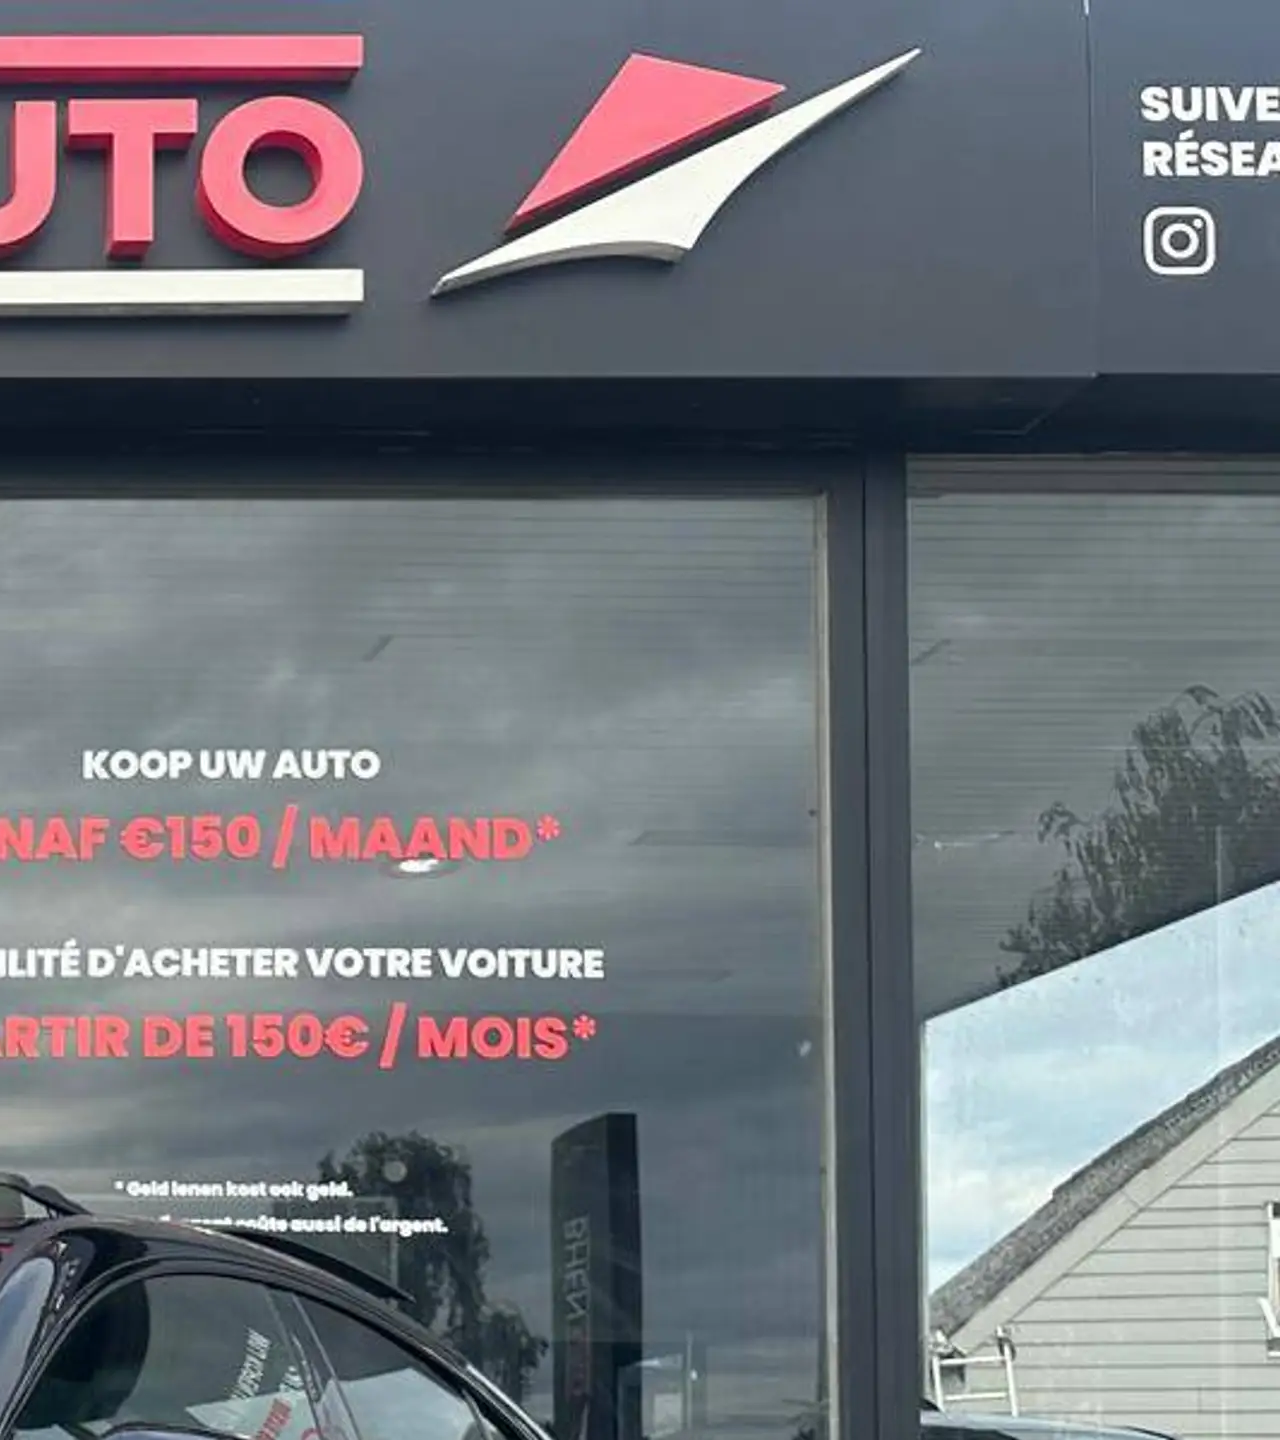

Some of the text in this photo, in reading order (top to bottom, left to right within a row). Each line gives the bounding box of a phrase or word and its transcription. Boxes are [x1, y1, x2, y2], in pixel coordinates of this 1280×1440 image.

[1140, 85, 1280, 121] SUIVE
[82, 748, 381, 780] KOOP UW AUTO
[118, 813, 261, 861] €150
[86, 945, 300, 979] D'ACHETER
[305, 947, 433, 978] VOTRE
[438, 948, 605, 980] VOITURE
[141, 1013, 214, 1060] DE
[223, 1013, 371, 1060] 150€
